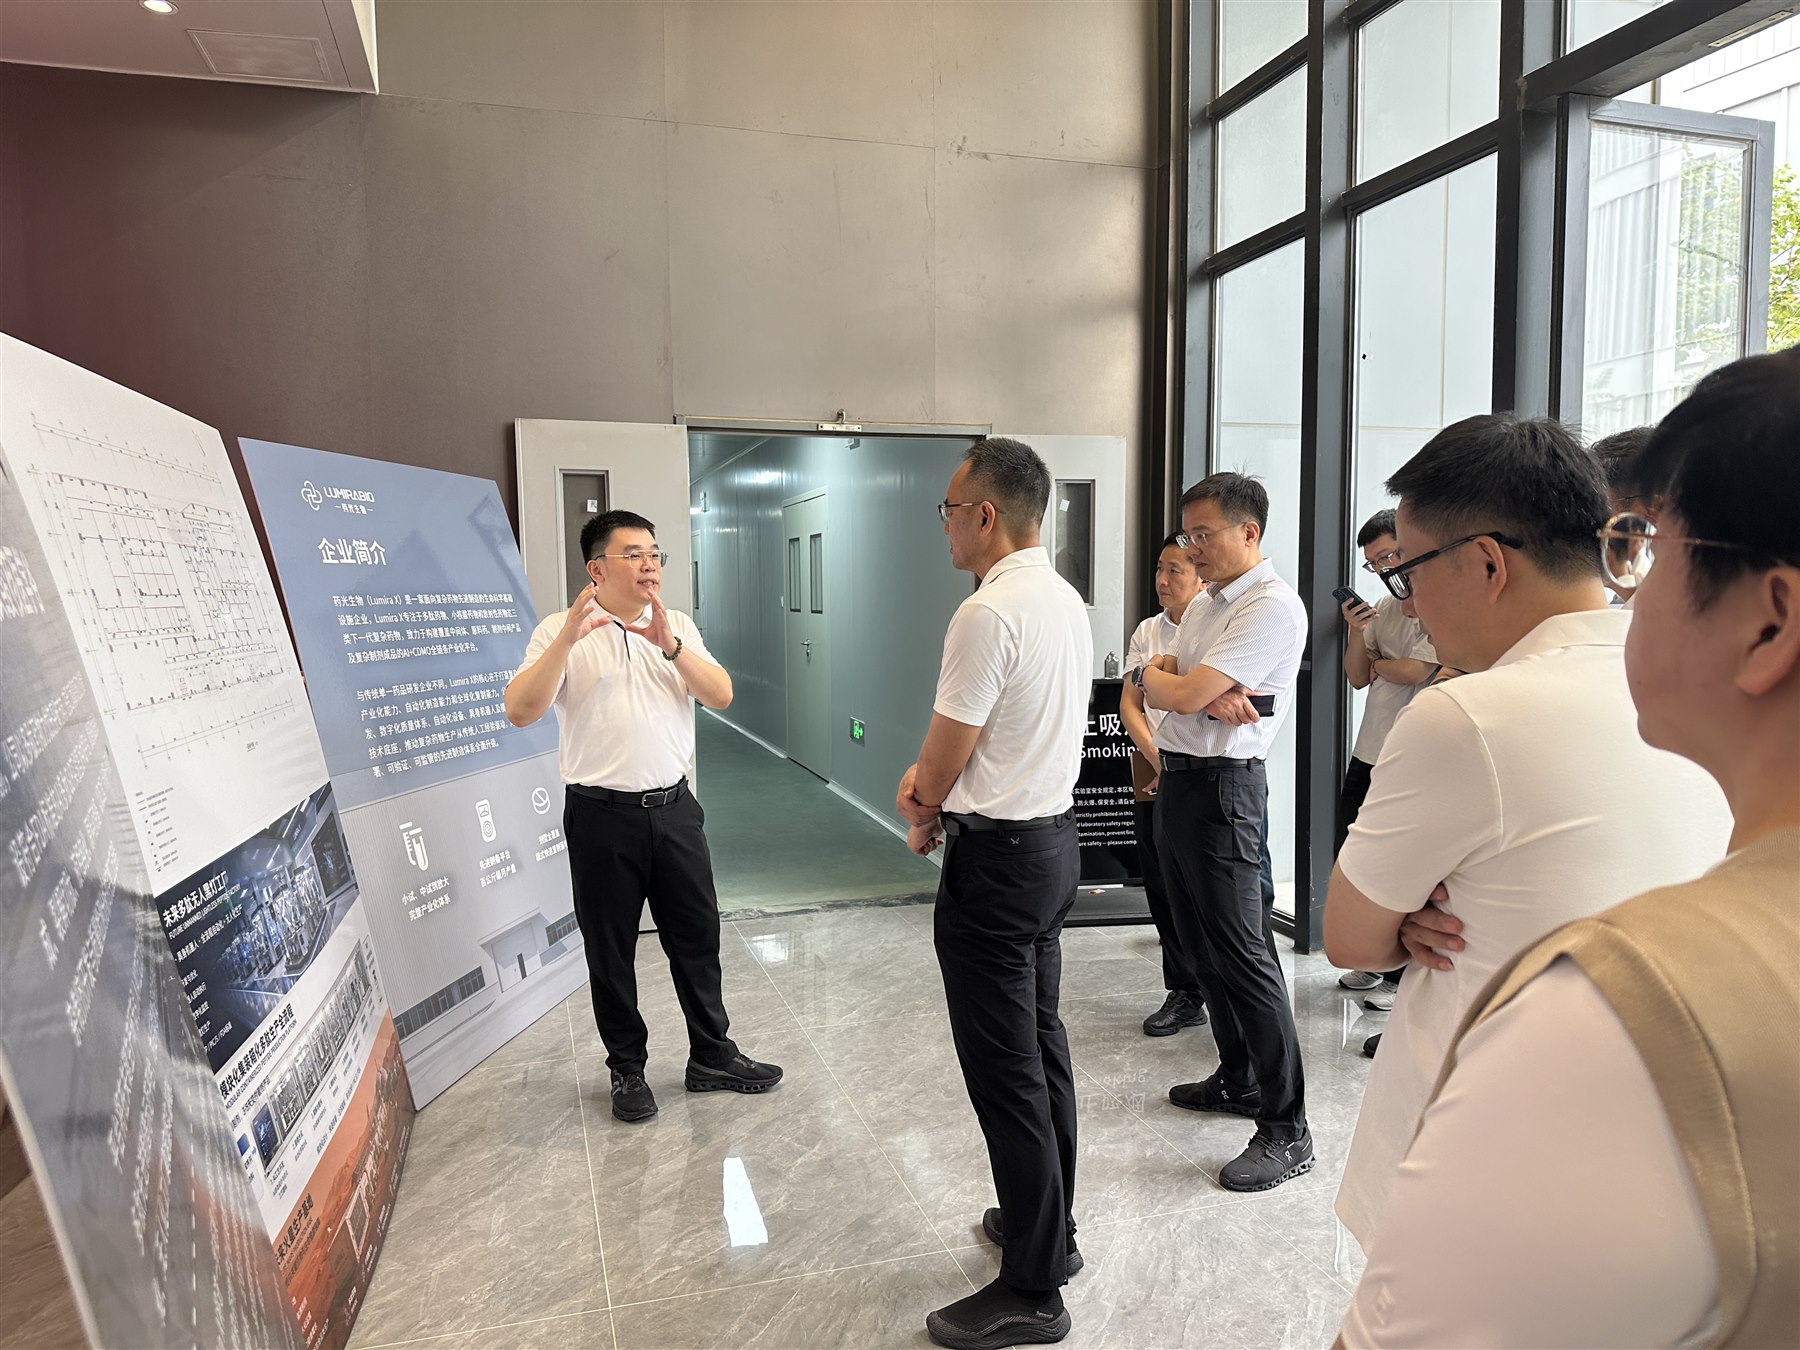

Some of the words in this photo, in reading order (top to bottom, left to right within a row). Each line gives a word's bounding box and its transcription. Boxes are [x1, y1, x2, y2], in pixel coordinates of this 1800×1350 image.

[323, 486, 375, 502] LUMIRABIO
[318, 538, 387, 566] 企业简介
[1080, 742, 1139, 758] Smokin
[162, 870, 227, 928] 未来多肽无人黑灯工厂
[401, 876, 450, 905] 小试、中试到放大
[408, 893, 451, 922] 完整产业化体系
